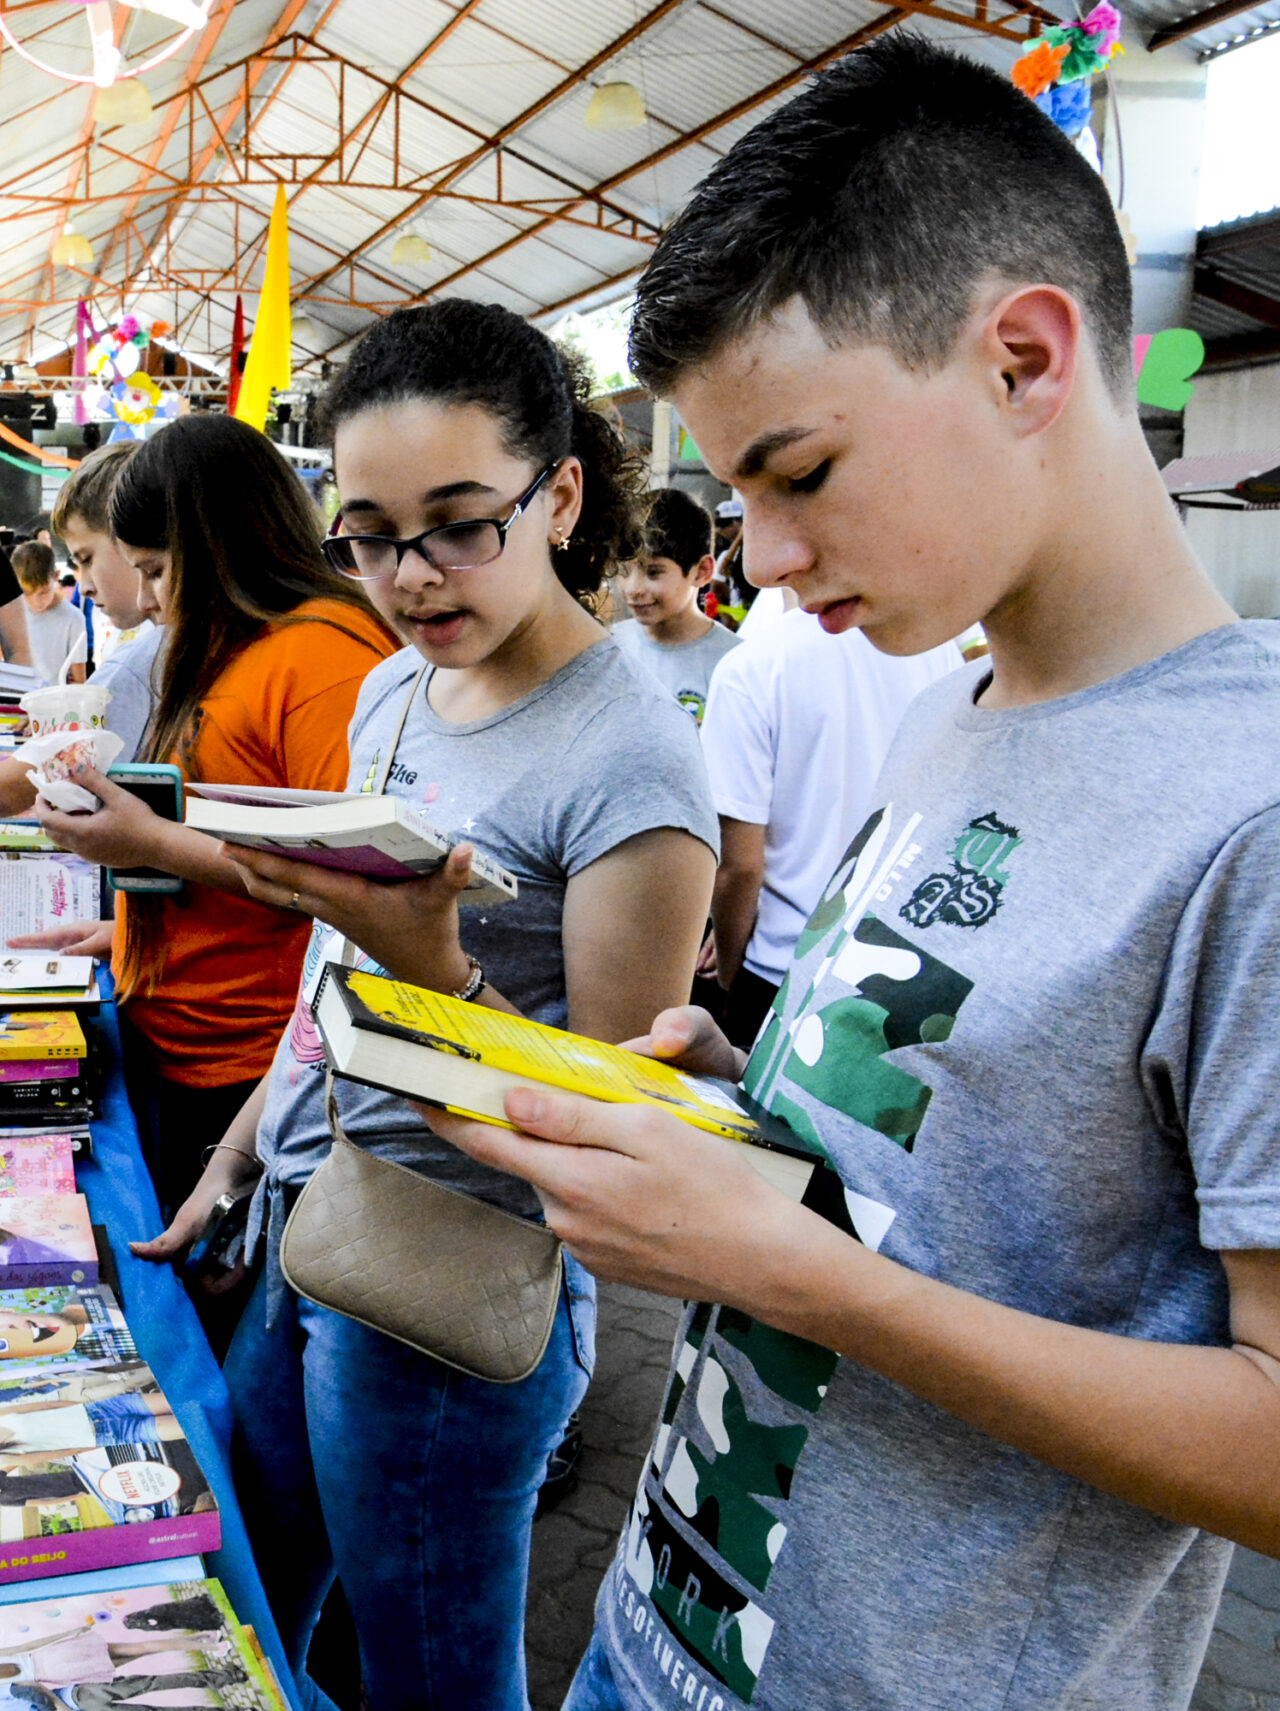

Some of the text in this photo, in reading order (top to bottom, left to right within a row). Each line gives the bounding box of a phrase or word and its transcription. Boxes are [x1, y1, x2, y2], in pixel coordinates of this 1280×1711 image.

[116, 1469, 140, 1500] NETFLIX
[10, 1555, 29, 1567] DO
[31, 1550, 67, 1564] BEIJO
[634, 1511, 740, 1663] YORK
